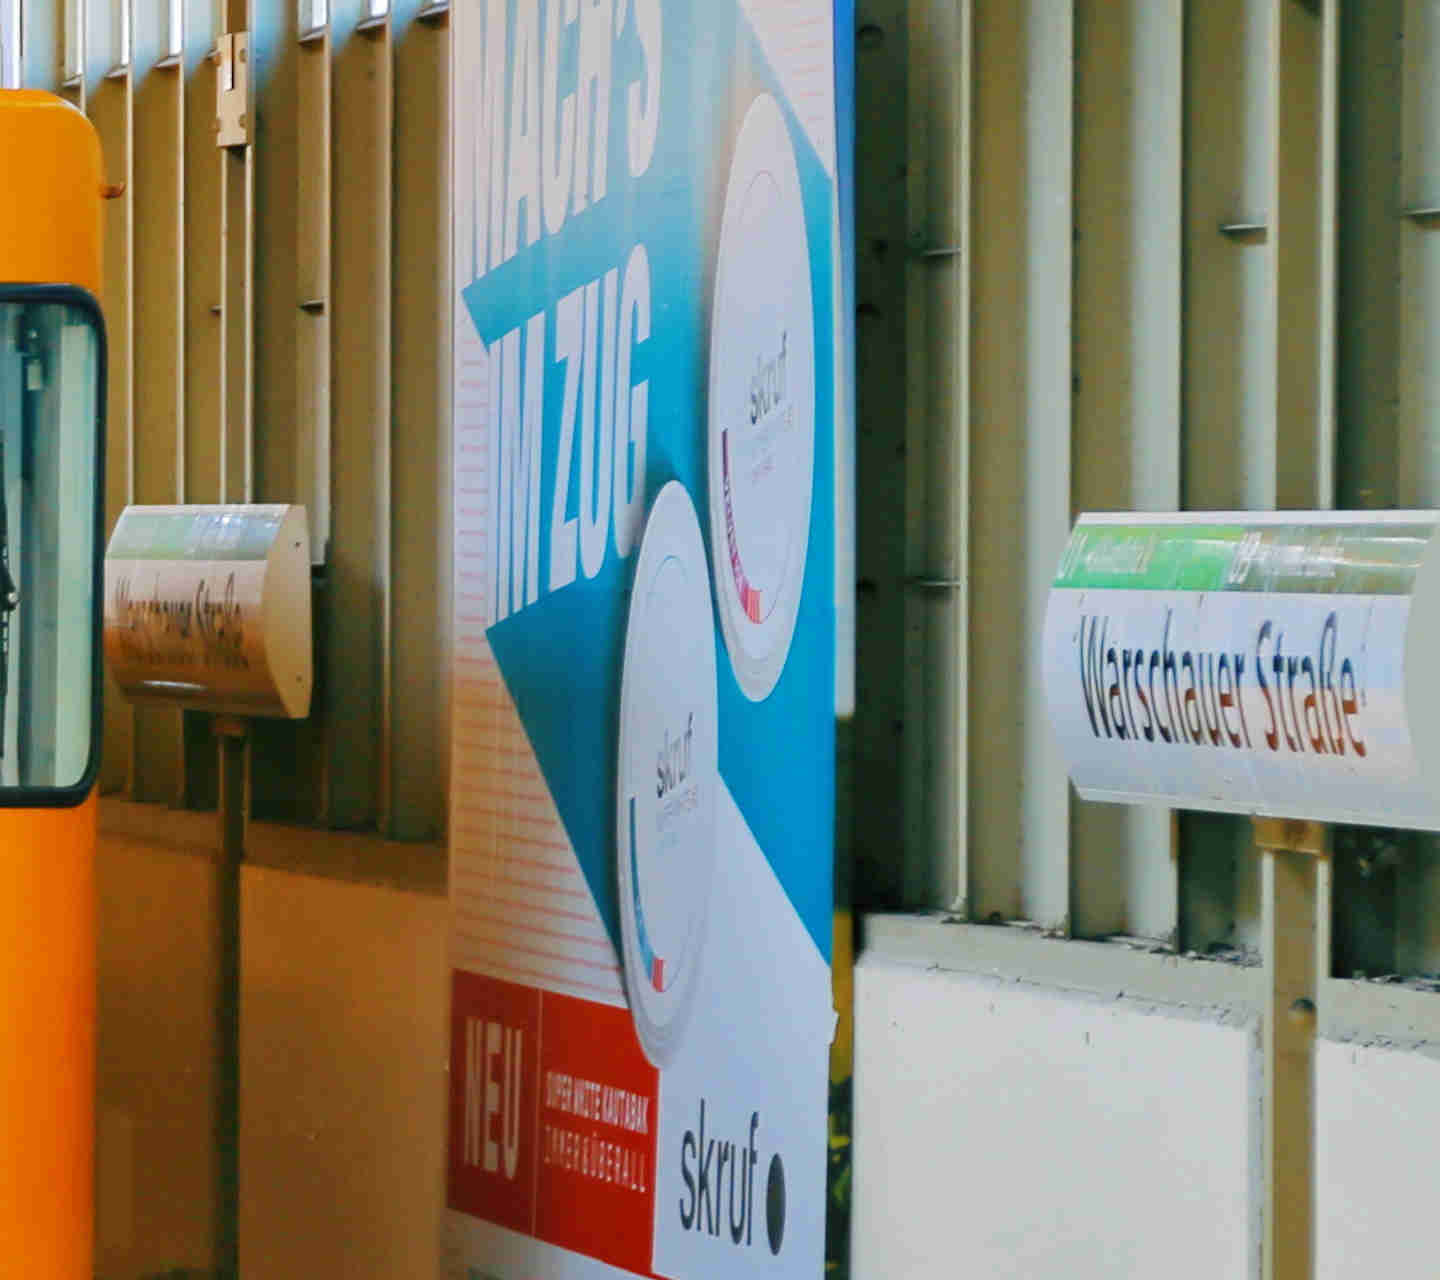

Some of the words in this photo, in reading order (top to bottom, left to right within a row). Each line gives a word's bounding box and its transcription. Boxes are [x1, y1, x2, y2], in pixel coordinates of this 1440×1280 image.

[486, 308, 547, 626] IM
[548, 242, 651, 590] ZUG
[1080, 608, 1252, 749] Warschauer
[1256, 610, 1367, 757] Straße
[463, 1014, 522, 1183] NEU
[679, 1098, 761, 1248] skruf
